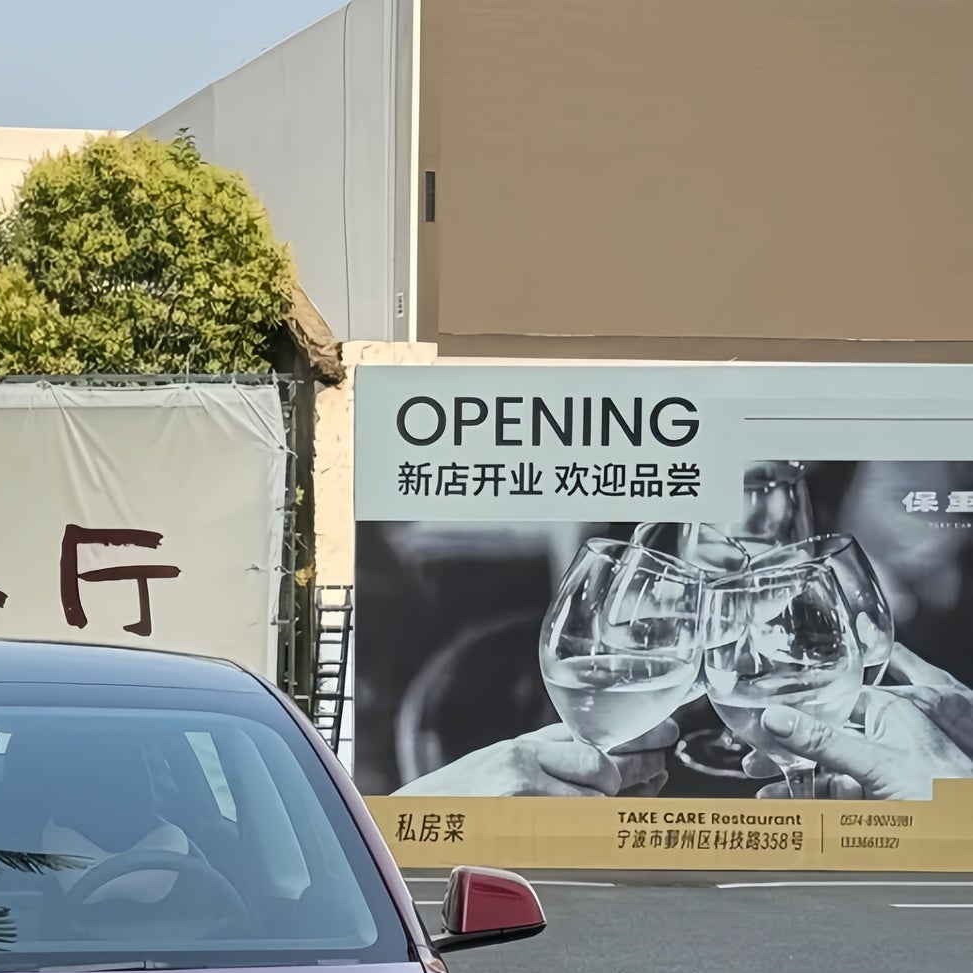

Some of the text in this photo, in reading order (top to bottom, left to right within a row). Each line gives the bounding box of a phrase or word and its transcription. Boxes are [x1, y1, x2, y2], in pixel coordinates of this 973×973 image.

[396, 395, 700, 447] OPENING
[398, 461, 701, 497] 新店开业 欢迎品尝
[395, 813, 466, 843] 私房菜
[618, 811, 658, 824] TAKE
[663, 812, 706, 825] CARE
